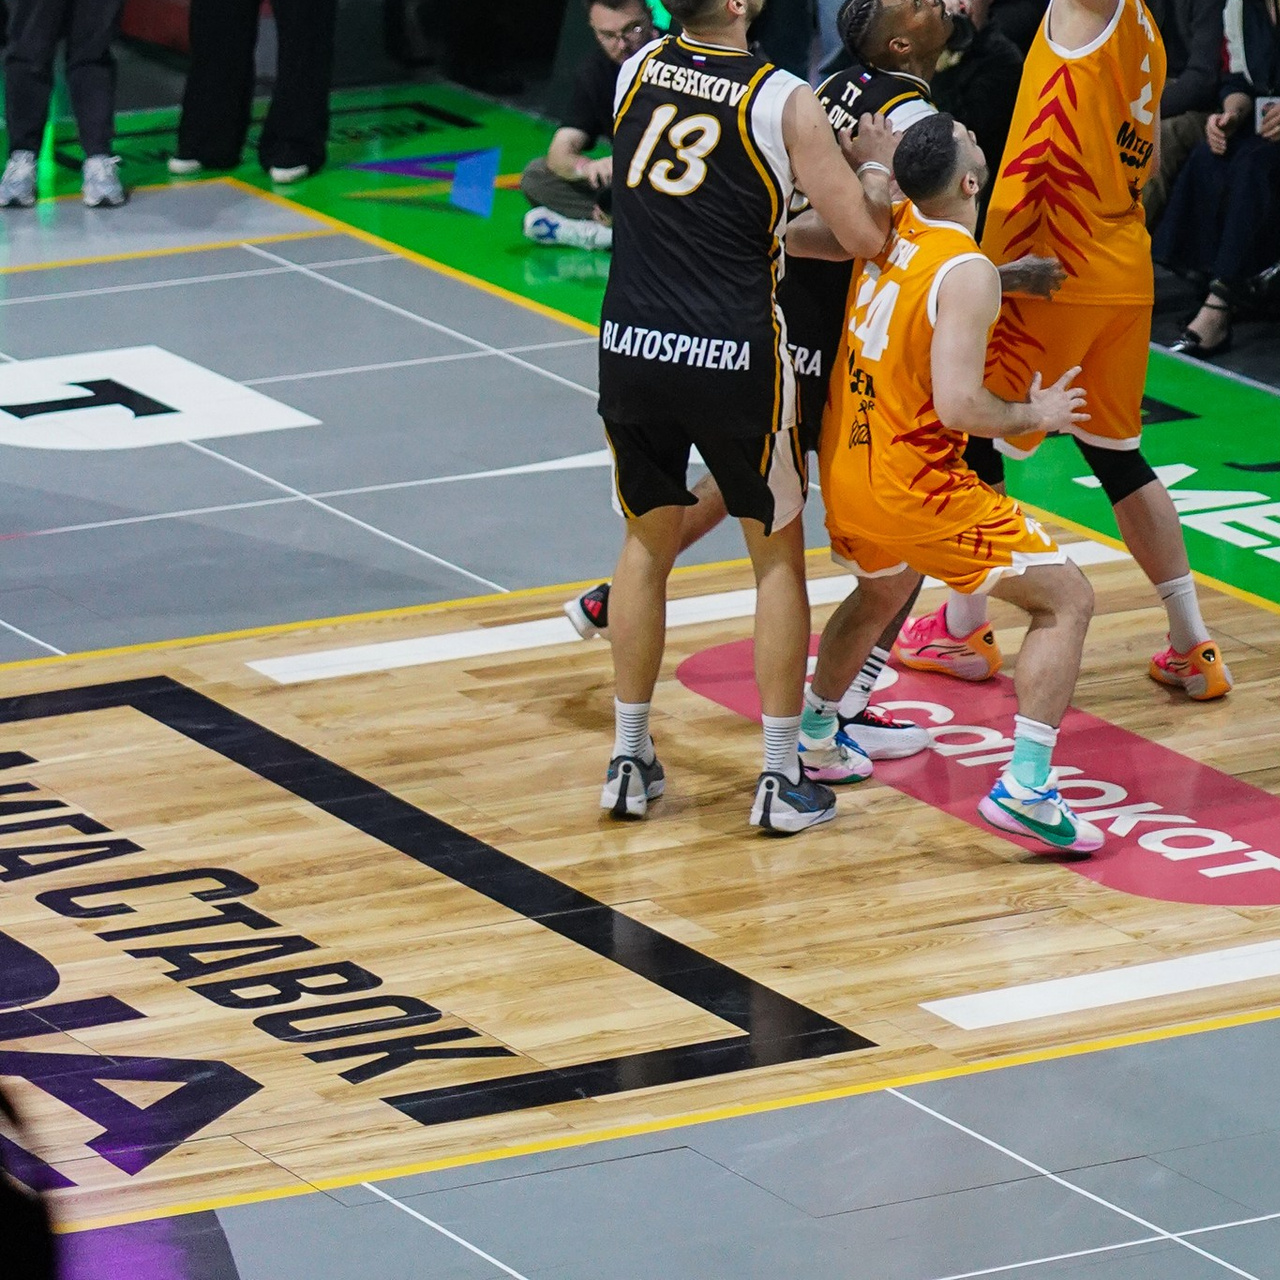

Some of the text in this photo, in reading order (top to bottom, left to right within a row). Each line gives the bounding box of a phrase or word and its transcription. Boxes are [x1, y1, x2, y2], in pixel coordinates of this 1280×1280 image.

[641, 58, 749, 108] MESHKOV
[840, 80, 863, 107] TY
[626, 102, 722, 197] 13
[602, 319, 750, 372] BLATOSPHERA
[35, 867, 521, 1085] СТАВОК
